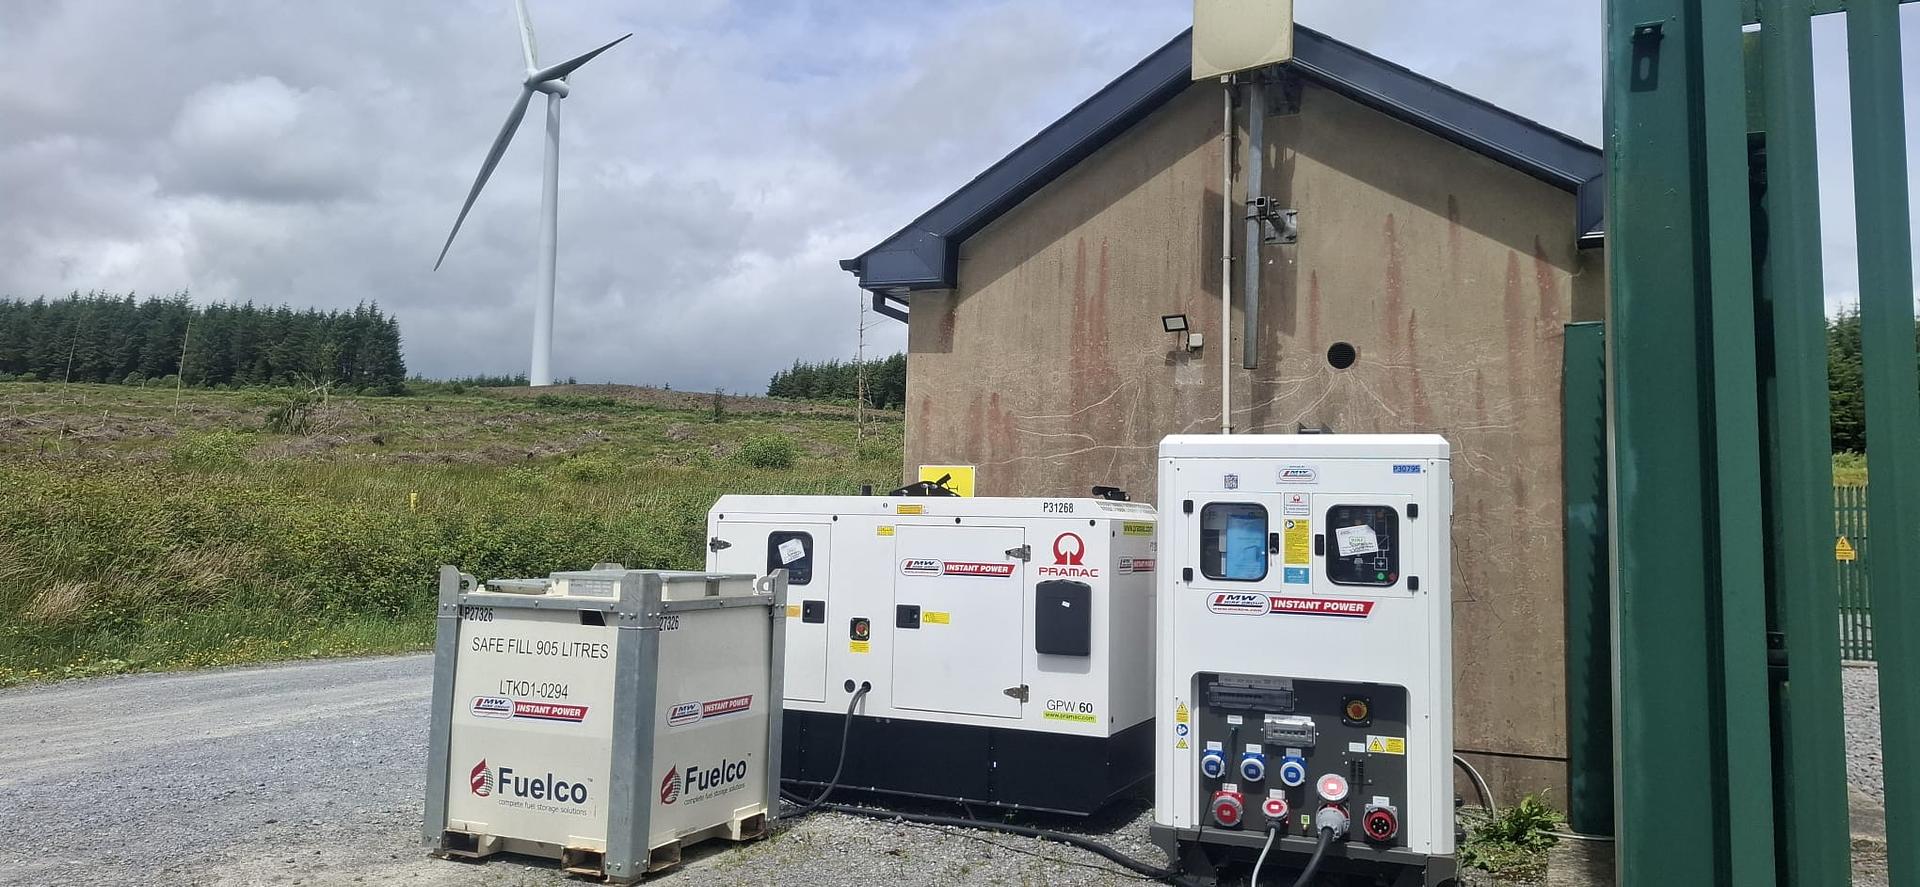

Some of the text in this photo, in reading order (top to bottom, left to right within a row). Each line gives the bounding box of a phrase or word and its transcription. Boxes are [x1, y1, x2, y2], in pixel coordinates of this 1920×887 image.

[1393, 465, 1420, 473] P30795
[1043, 502, 1074, 513] P31268
[946, 563, 1009, 573] INSTANT POWER
[1038, 567, 1099, 577] PRAMAC
[1273, 599, 1321, 610] INSTANT
[1323, 601, 1365, 612] POWER
[465, 606, 494, 622] P27326
[472, 637, 608, 659] SAFE FILL 905 LITRES
[499, 680, 568, 699] LTKD1-0294
[516, 704, 551, 715] INSTANT
[552, 706, 581, 717] POWER
[678, 704, 696, 712] MW
[704, 697, 749, 713] INSTANT POWER
[1046, 699, 1093, 713] GPW 60
[1045, 712, 1095, 721] www.pramac.com
[684, 759, 747, 795] Fuelco
[498, 766, 588, 804] Fuelco
[499, 799, 587, 816] complete fuel storage solutions
